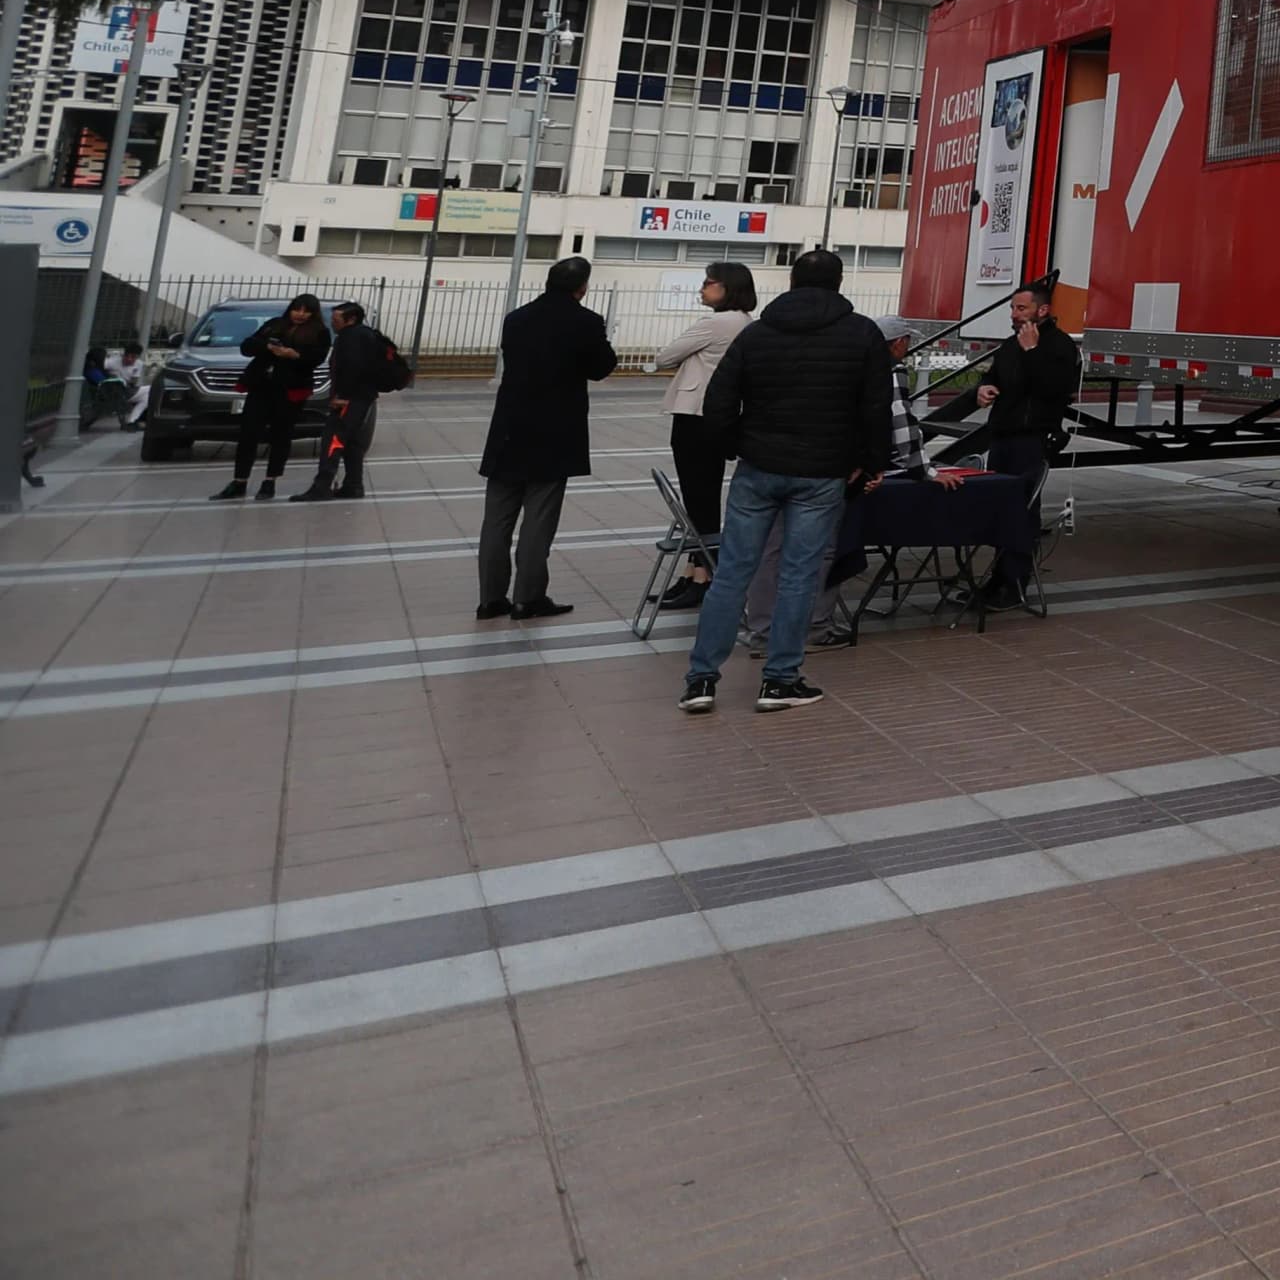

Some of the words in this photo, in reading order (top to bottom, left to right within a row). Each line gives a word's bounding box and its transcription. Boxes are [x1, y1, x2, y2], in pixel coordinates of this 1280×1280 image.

[82, 40, 174, 57] ChileAnde
[939, 86, 984, 127] ACADEM
[934, 132, 979, 173] INTELIGE
[930, 181, 973, 217] ARTIFICI
[674, 208, 712, 221] Chile
[672, 221, 726, 234] Atiende
[980, 263, 997, 279] Claro
